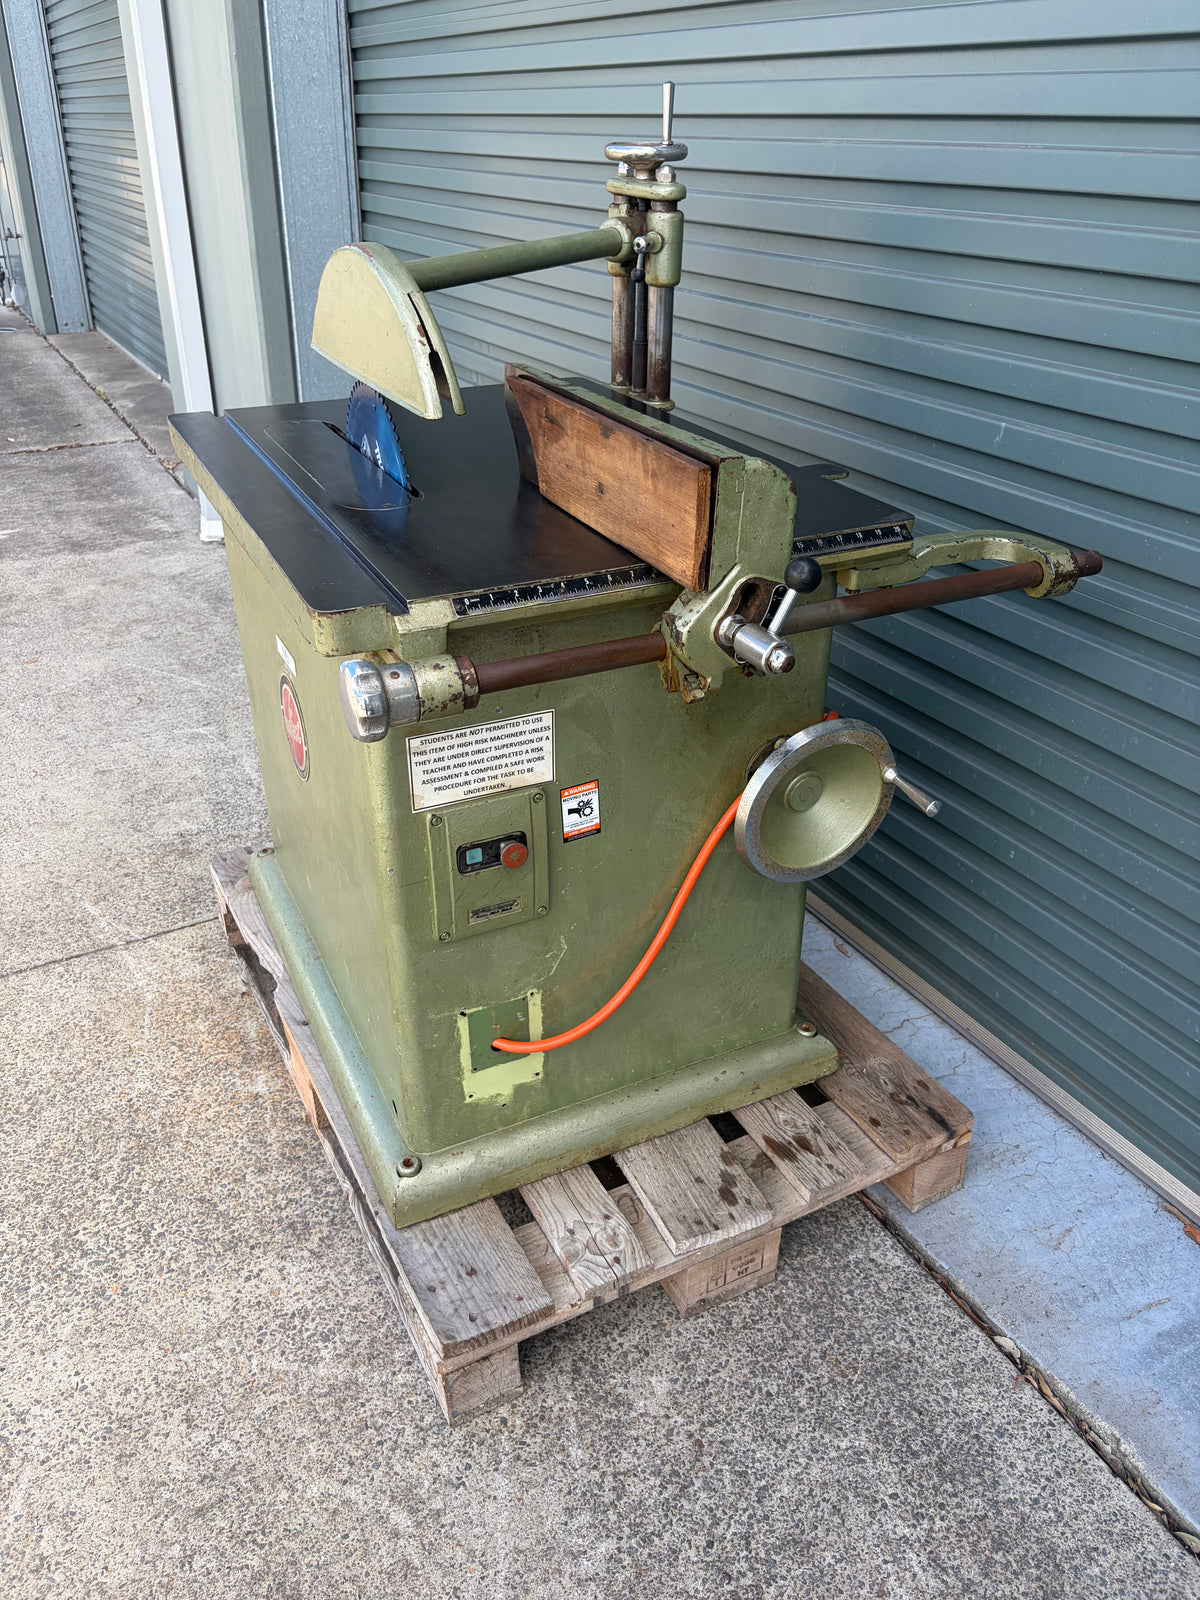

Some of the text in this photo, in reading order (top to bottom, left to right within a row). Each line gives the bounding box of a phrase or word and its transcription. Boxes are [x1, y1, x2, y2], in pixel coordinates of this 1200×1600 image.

[420, 734, 453, 745] STUDENTS
[469, 728, 484, 736] NOT
[486, 721, 520, 733] PERMITTED
[429, 746, 445, 754] ITEM
[457, 740, 473, 749] HIGH
[475, 737, 488, 745] RISK
[490, 730, 526, 742] MACHINERY
[528, 726, 550, 734] UNLESS
[415, 759, 431, 768] THEY
[447, 751, 469, 761] UNDER
[471, 747, 492, 756] DIRECT
[494, 738, 534, 751] SUPERVISION
[422, 765, 451, 775] TEACHER
[468, 758, 485, 766] HAVE
[487, 750, 523, 762] COMPLETED
[422, 772, 463, 785] ASSESSMENT
[471, 762, 502, 775] COMPILED
[526, 755, 545, 764] WORK
[434, 780, 472, 792] PROCEDURE
[500, 770, 516, 779] TASK
[463, 783, 506, 796] UNDERTAKEN.
[569, 783, 595, 794] WARNING
